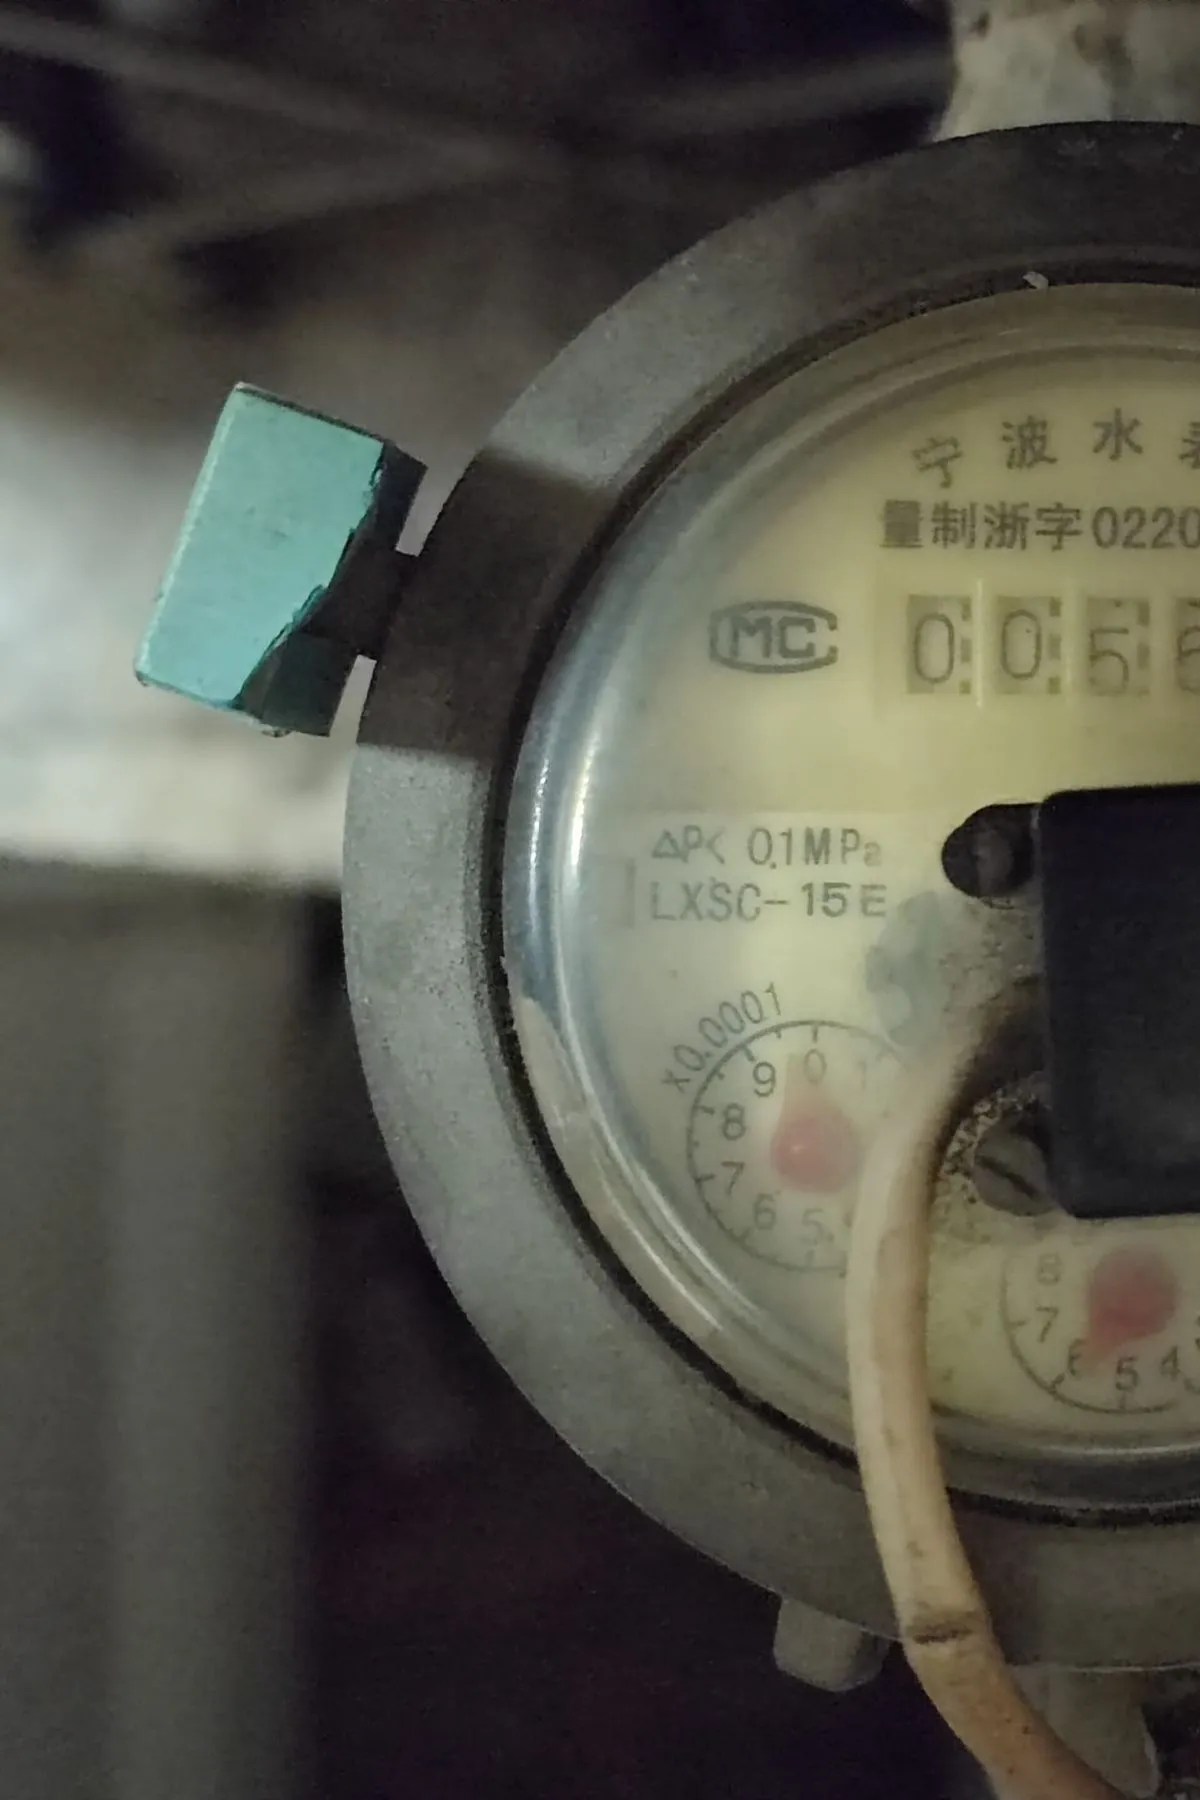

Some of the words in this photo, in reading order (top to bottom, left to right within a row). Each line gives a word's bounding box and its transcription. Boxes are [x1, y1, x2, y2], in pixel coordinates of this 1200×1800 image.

[752, 1060, 777, 1099] 9
[721, 1103, 746, 1142] 8
[721, 1160, 745, 1196] 7
[752, 1193, 777, 1231] 6
[1035, 1306, 1060, 1343] 7
[1114, 1355, 1139, 1393] 5
[1160, 1345, 1182, 1382] 4
